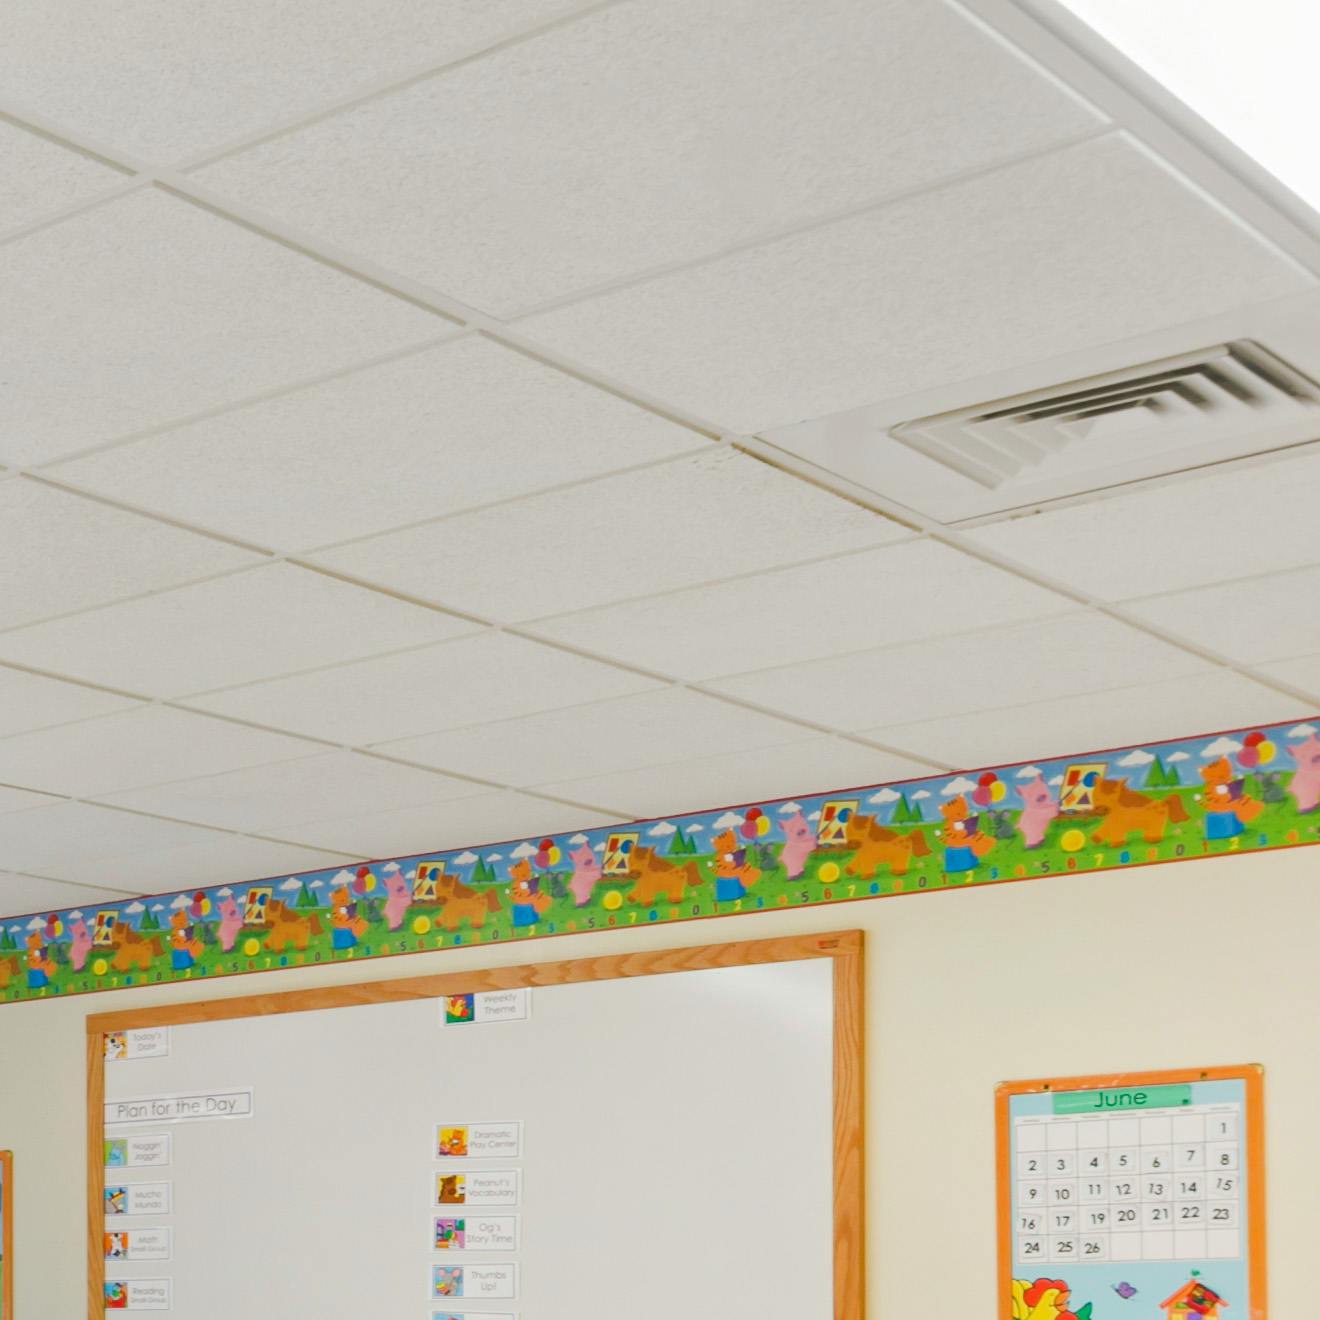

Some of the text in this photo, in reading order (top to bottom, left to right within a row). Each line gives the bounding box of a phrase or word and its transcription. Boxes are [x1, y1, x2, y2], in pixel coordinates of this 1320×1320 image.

[919, 876, 927, 888] 0
[1041, 861, 1050, 873] 5
[801, 891, 809, 902] 5
[588, 917, 595, 928] 5
[117, 1097, 237, 1118] Plan for the Day
[1094, 1091, 1148, 1108] June
[1028, 1150, 1230, 1172] 2 3 4 5 6 7 8
[1029, 1178, 1232, 1200] 9 10 11 12 13 14 15
[1021, 1206, 1230, 1230] 16 17 19 20 21 22 23
[492, 1234, 512, 1242] Time
[1024, 1241, 1100, 1254] 24 25 26
[471, 1270, 507, 1280] Thumbs
